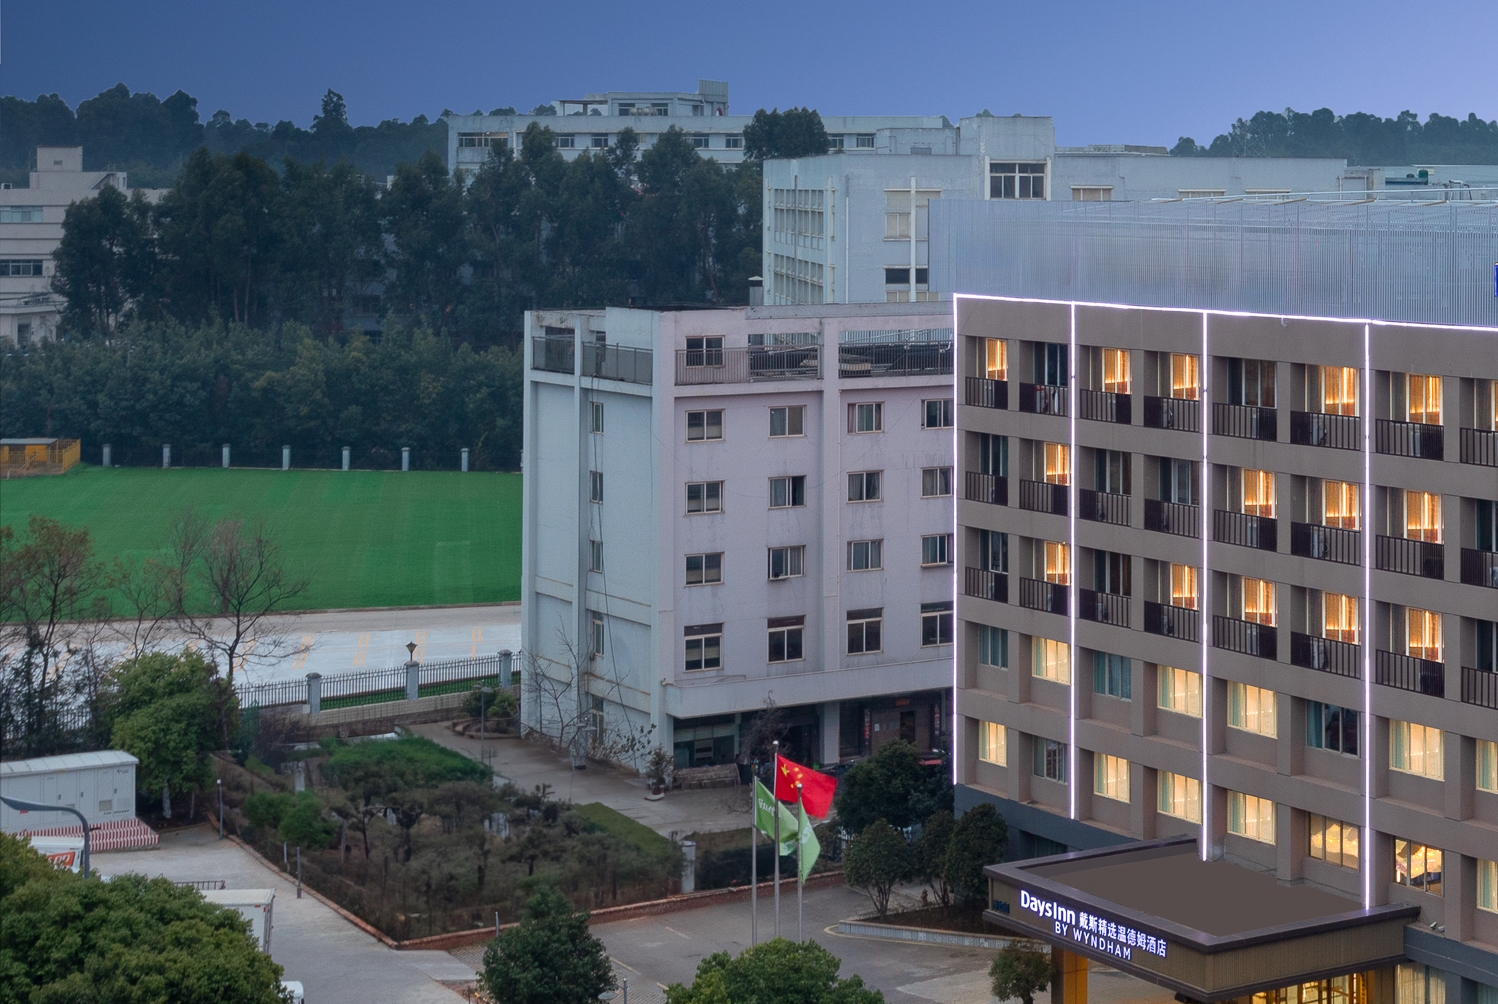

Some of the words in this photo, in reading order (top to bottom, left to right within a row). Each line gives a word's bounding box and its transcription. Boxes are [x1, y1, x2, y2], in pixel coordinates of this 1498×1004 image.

[1055, 921, 1068, 936] BY
[1072, 927, 1131, 960] WYNDHAM
[1079, 911, 1167, 957] 戴斯精选温德姆酒店
